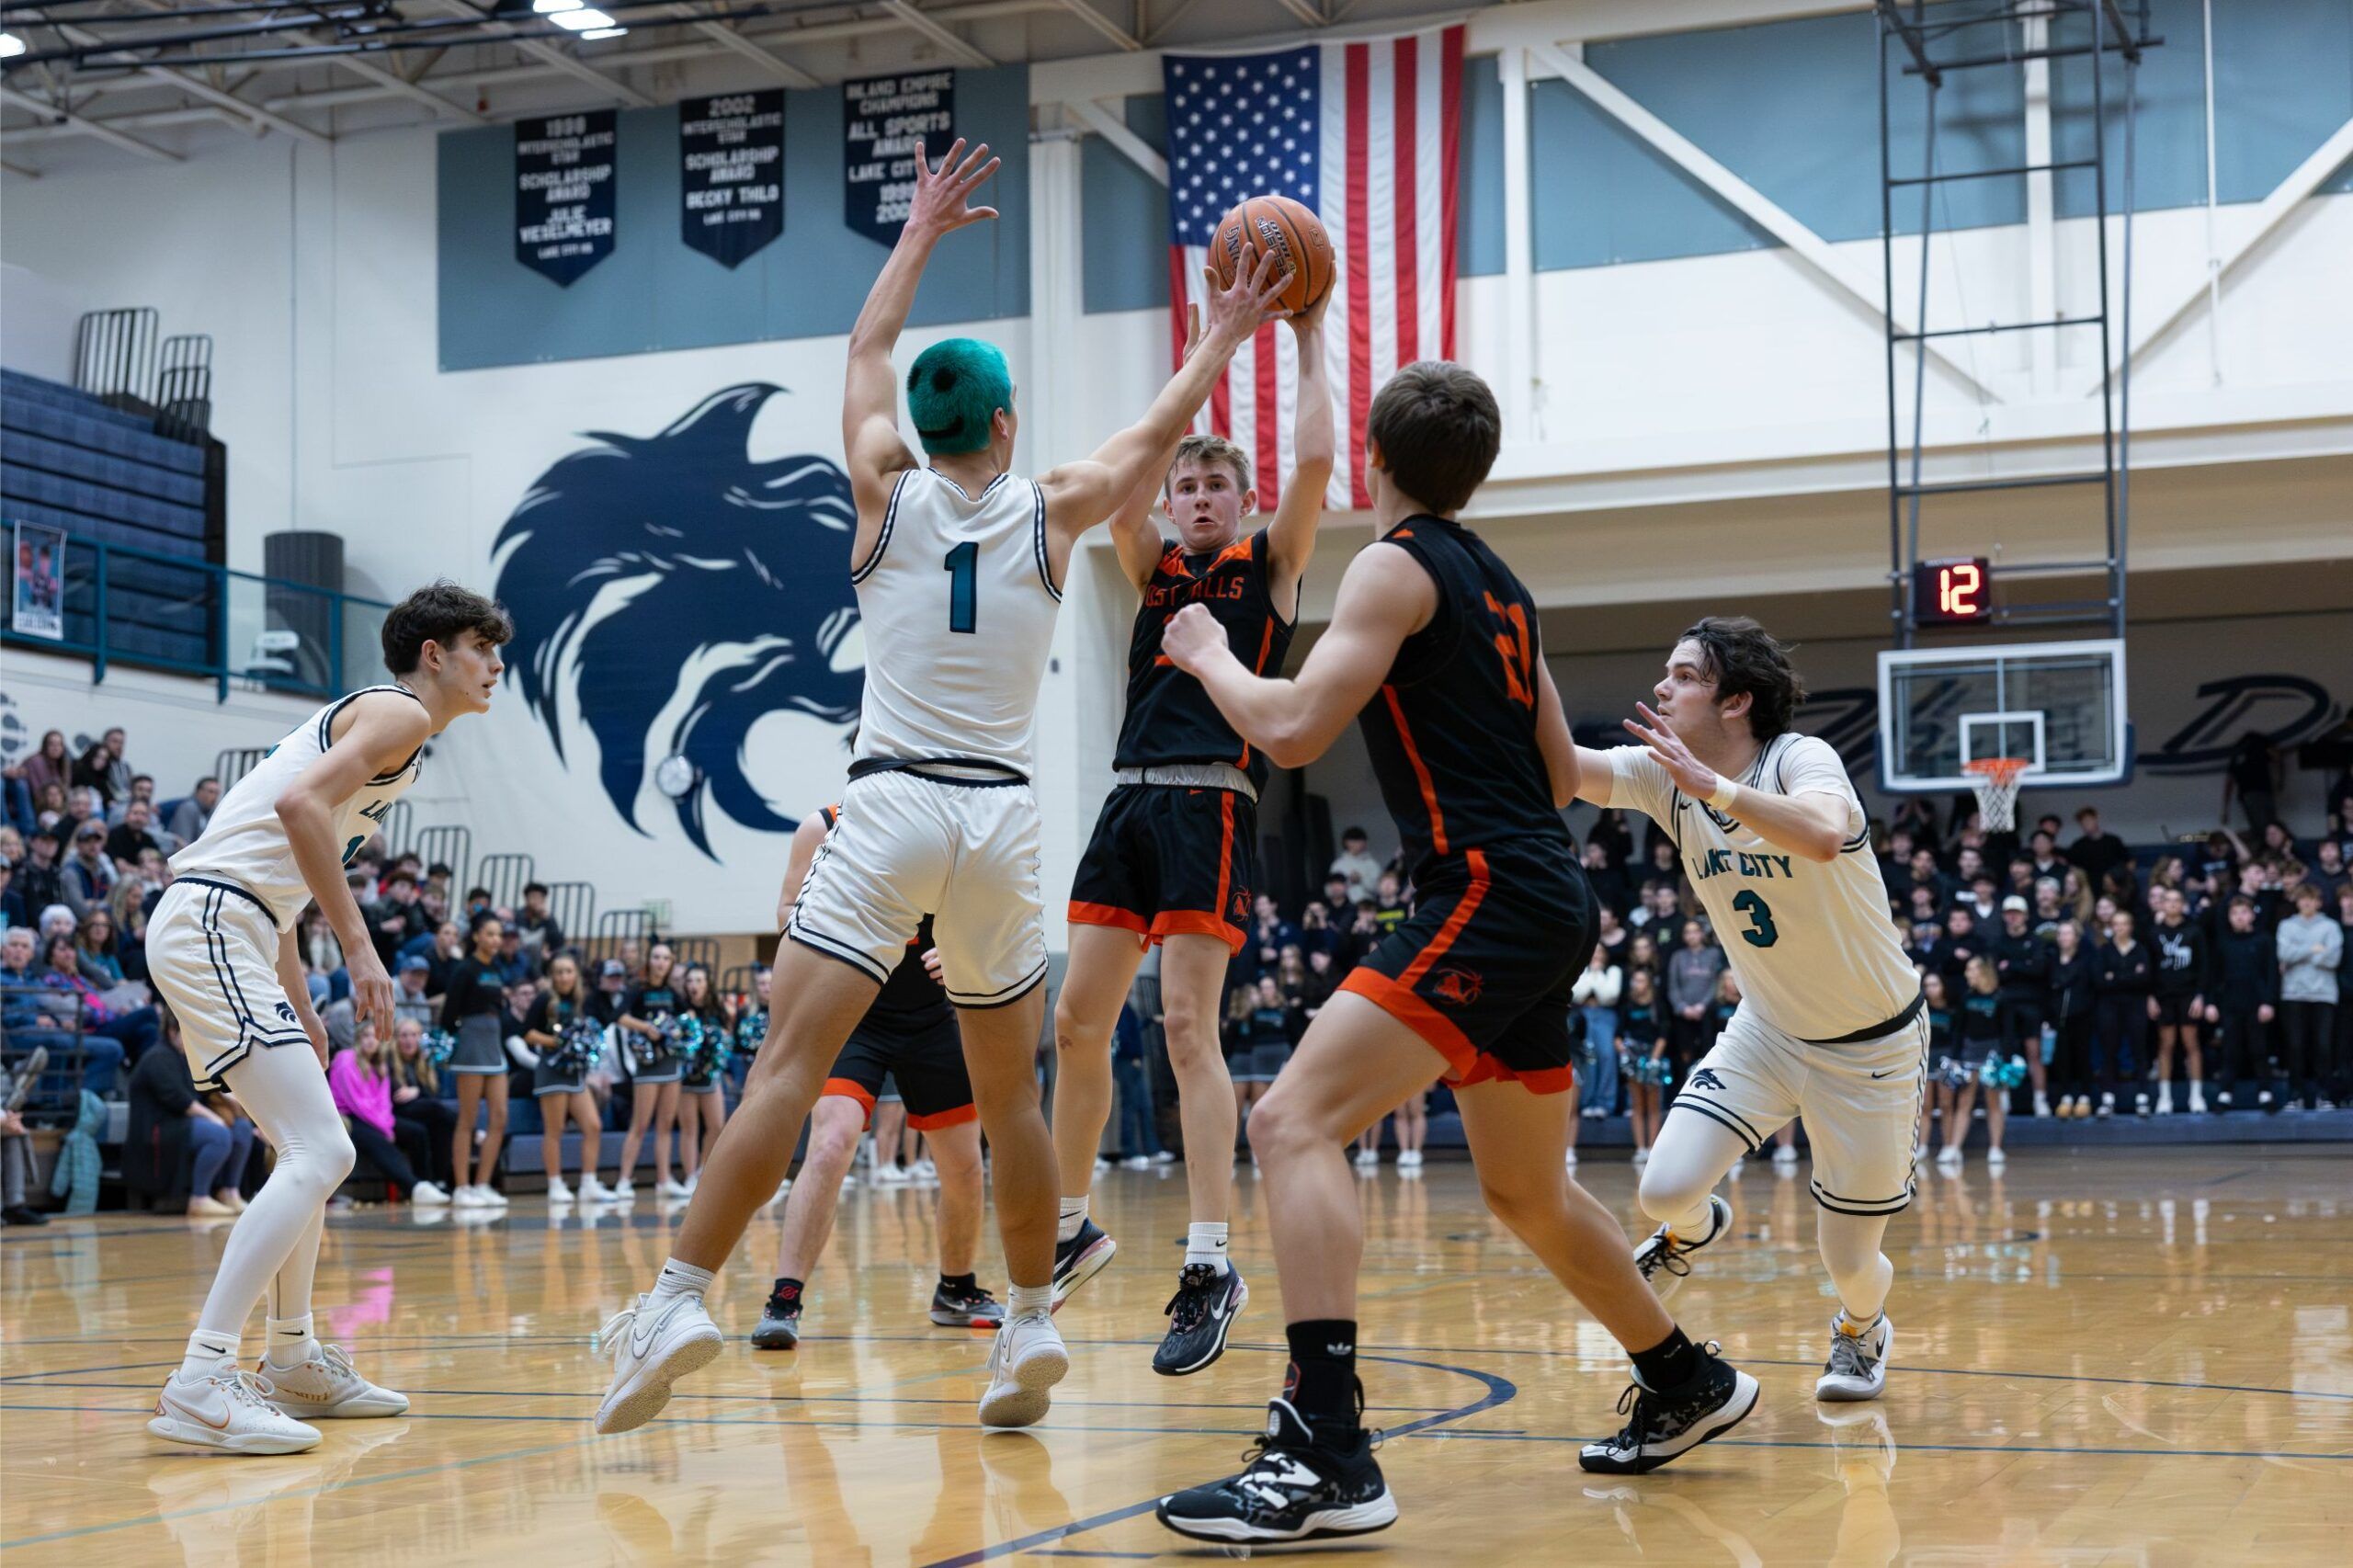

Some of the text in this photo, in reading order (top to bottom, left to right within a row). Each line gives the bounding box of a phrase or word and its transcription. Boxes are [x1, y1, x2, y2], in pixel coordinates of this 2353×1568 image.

[847, 74, 951, 99] INLAND EMPIRE
[710, 96, 755, 117] 2002
[848, 112, 950, 141] ALL SPORTS
[686, 146, 779, 171] SCHOLARSHIP
[519, 165, 611, 190] SCHOLARSHIP
[710, 165, 755, 184] AWARD
[848, 163, 885, 182] LAKE
[546, 184, 590, 202] AWARD
[687, 186, 779, 210] BECKY THILO
[547, 206, 586, 223] JULIE
[944, 541, 979, 634] 1
[1940, 565, 1980, 614] 12
[1736, 846, 1793, 878] CITY
[1733, 889, 1779, 948] 3
